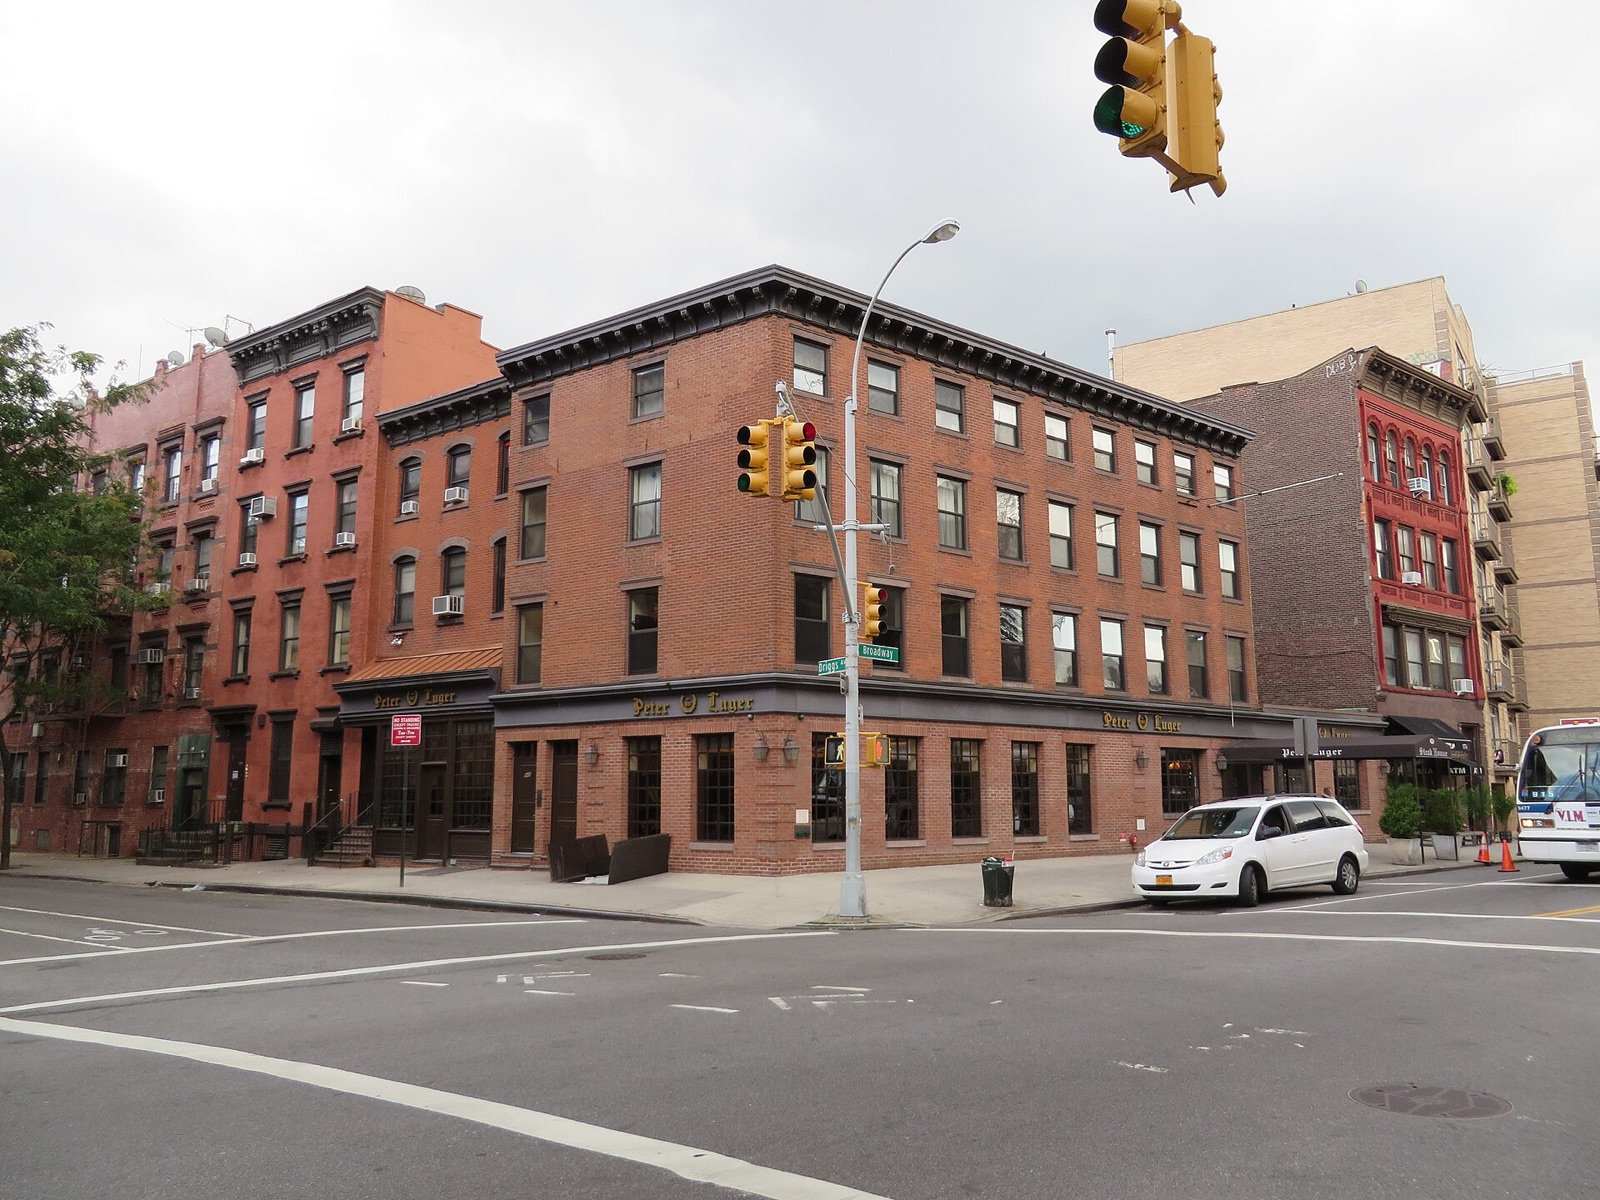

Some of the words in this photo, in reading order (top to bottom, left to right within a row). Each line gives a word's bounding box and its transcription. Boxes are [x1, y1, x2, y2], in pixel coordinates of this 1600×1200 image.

[863, 645, 893, 660] Broadway
[818, 661, 839, 673] Driggs
[374, 694, 400, 709] Peter
[424, 688, 455, 705] Luger
[632, 697, 670, 717] Peter
[707, 691, 754, 714] Luger
[1103, 711, 1131, 728] Peter
[1154, 714, 1181, 733] Luger
[1313, 748, 1342, 757] uger
[1419, 747, 1432, 756] Steak
[1433, 748, 1448, 757] House
